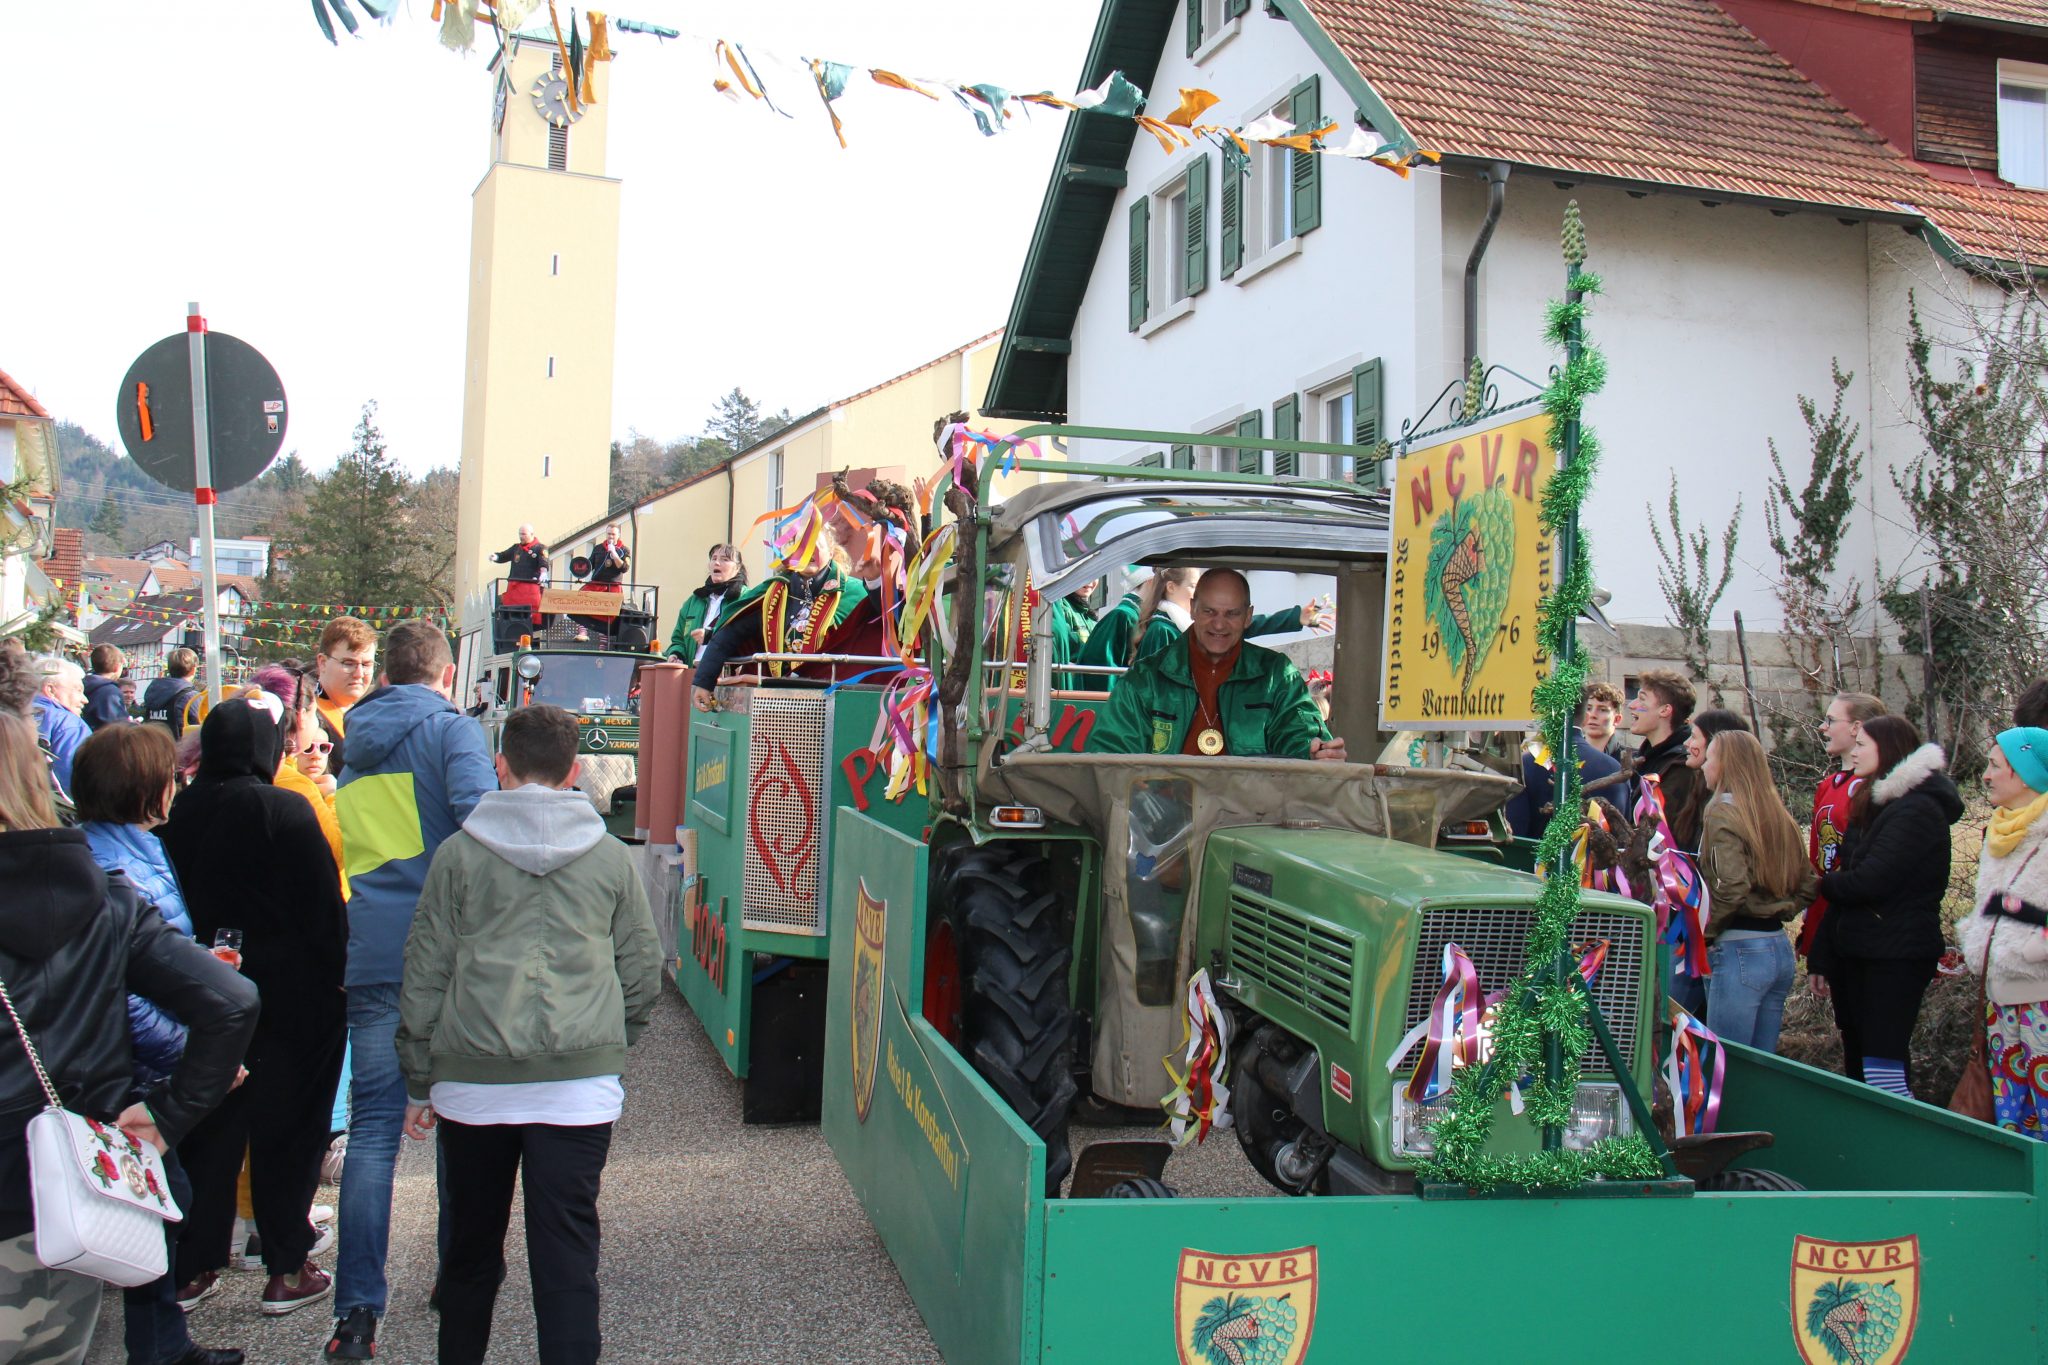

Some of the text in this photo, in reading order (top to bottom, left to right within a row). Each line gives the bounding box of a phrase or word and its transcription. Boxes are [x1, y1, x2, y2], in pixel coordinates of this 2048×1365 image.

[1410, 433, 1539, 527] NCVR
[1420, 615, 1521, 659] 19 76
[691, 870, 727, 996] Hoch
[905, 1070, 913, 1113] &
[914, 1083, 953, 1183] Konstantin
[1196, 1257, 1299, 1284] NCVR
[1806, 1244, 1902, 1269] NCVR
